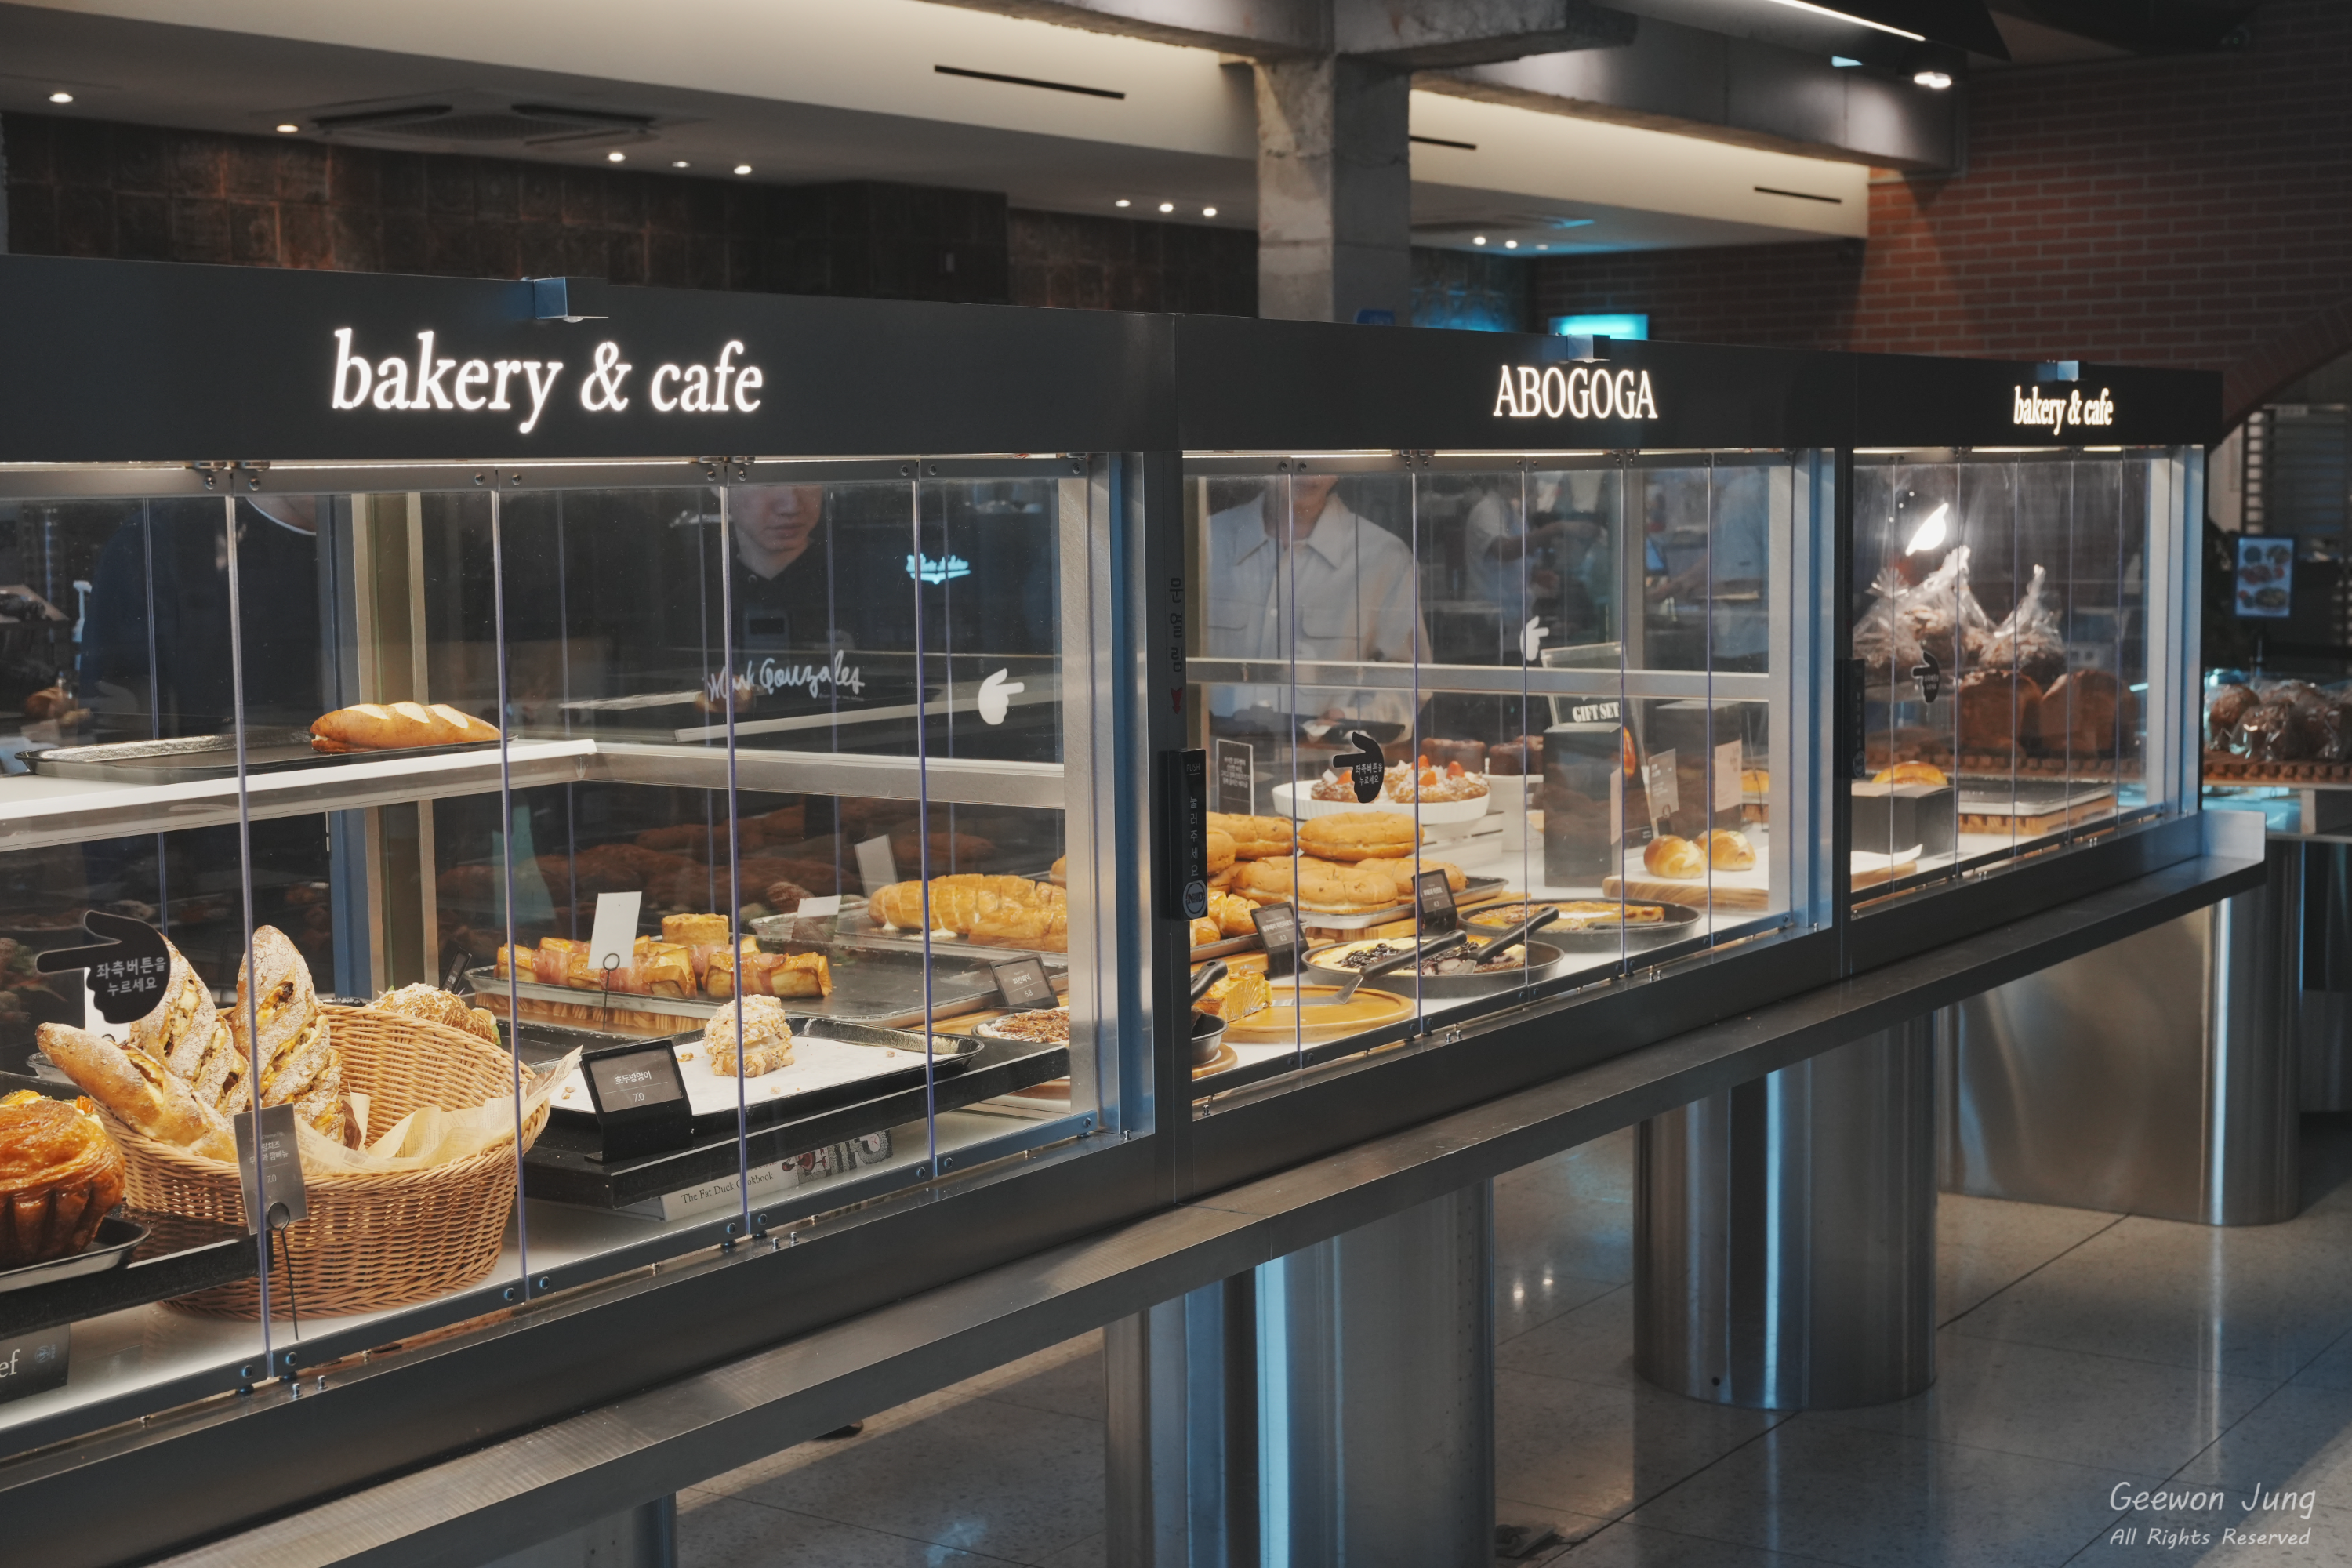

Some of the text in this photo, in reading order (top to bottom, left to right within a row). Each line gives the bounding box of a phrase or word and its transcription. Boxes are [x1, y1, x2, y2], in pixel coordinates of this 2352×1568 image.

[332, 328, 763, 434] bakery & cafe
[1493, 365, 1658, 419] ABOGOGA
[2013, 385, 2114, 436] bakery & cafe
[760, 649, 865, 699] Gonzales
[1572, 701, 1620, 723] GIFT SET
[1186, 763, 1200, 772] PUSH
[1359, 775, 1379, 786] 누르세요
[96, 956, 166, 979] 좌측버튼을
[107, 976, 158, 996] 누르세요
[614, 1070, 652, 1085] 호두방망이
[632, 1092, 645, 1102] 7.0
[252, 1141, 281, 1152] 림치즈
[249, 1153, 268, 1165] 무과
[681, 1171, 774, 1203] The Fat Duck Cokbook
